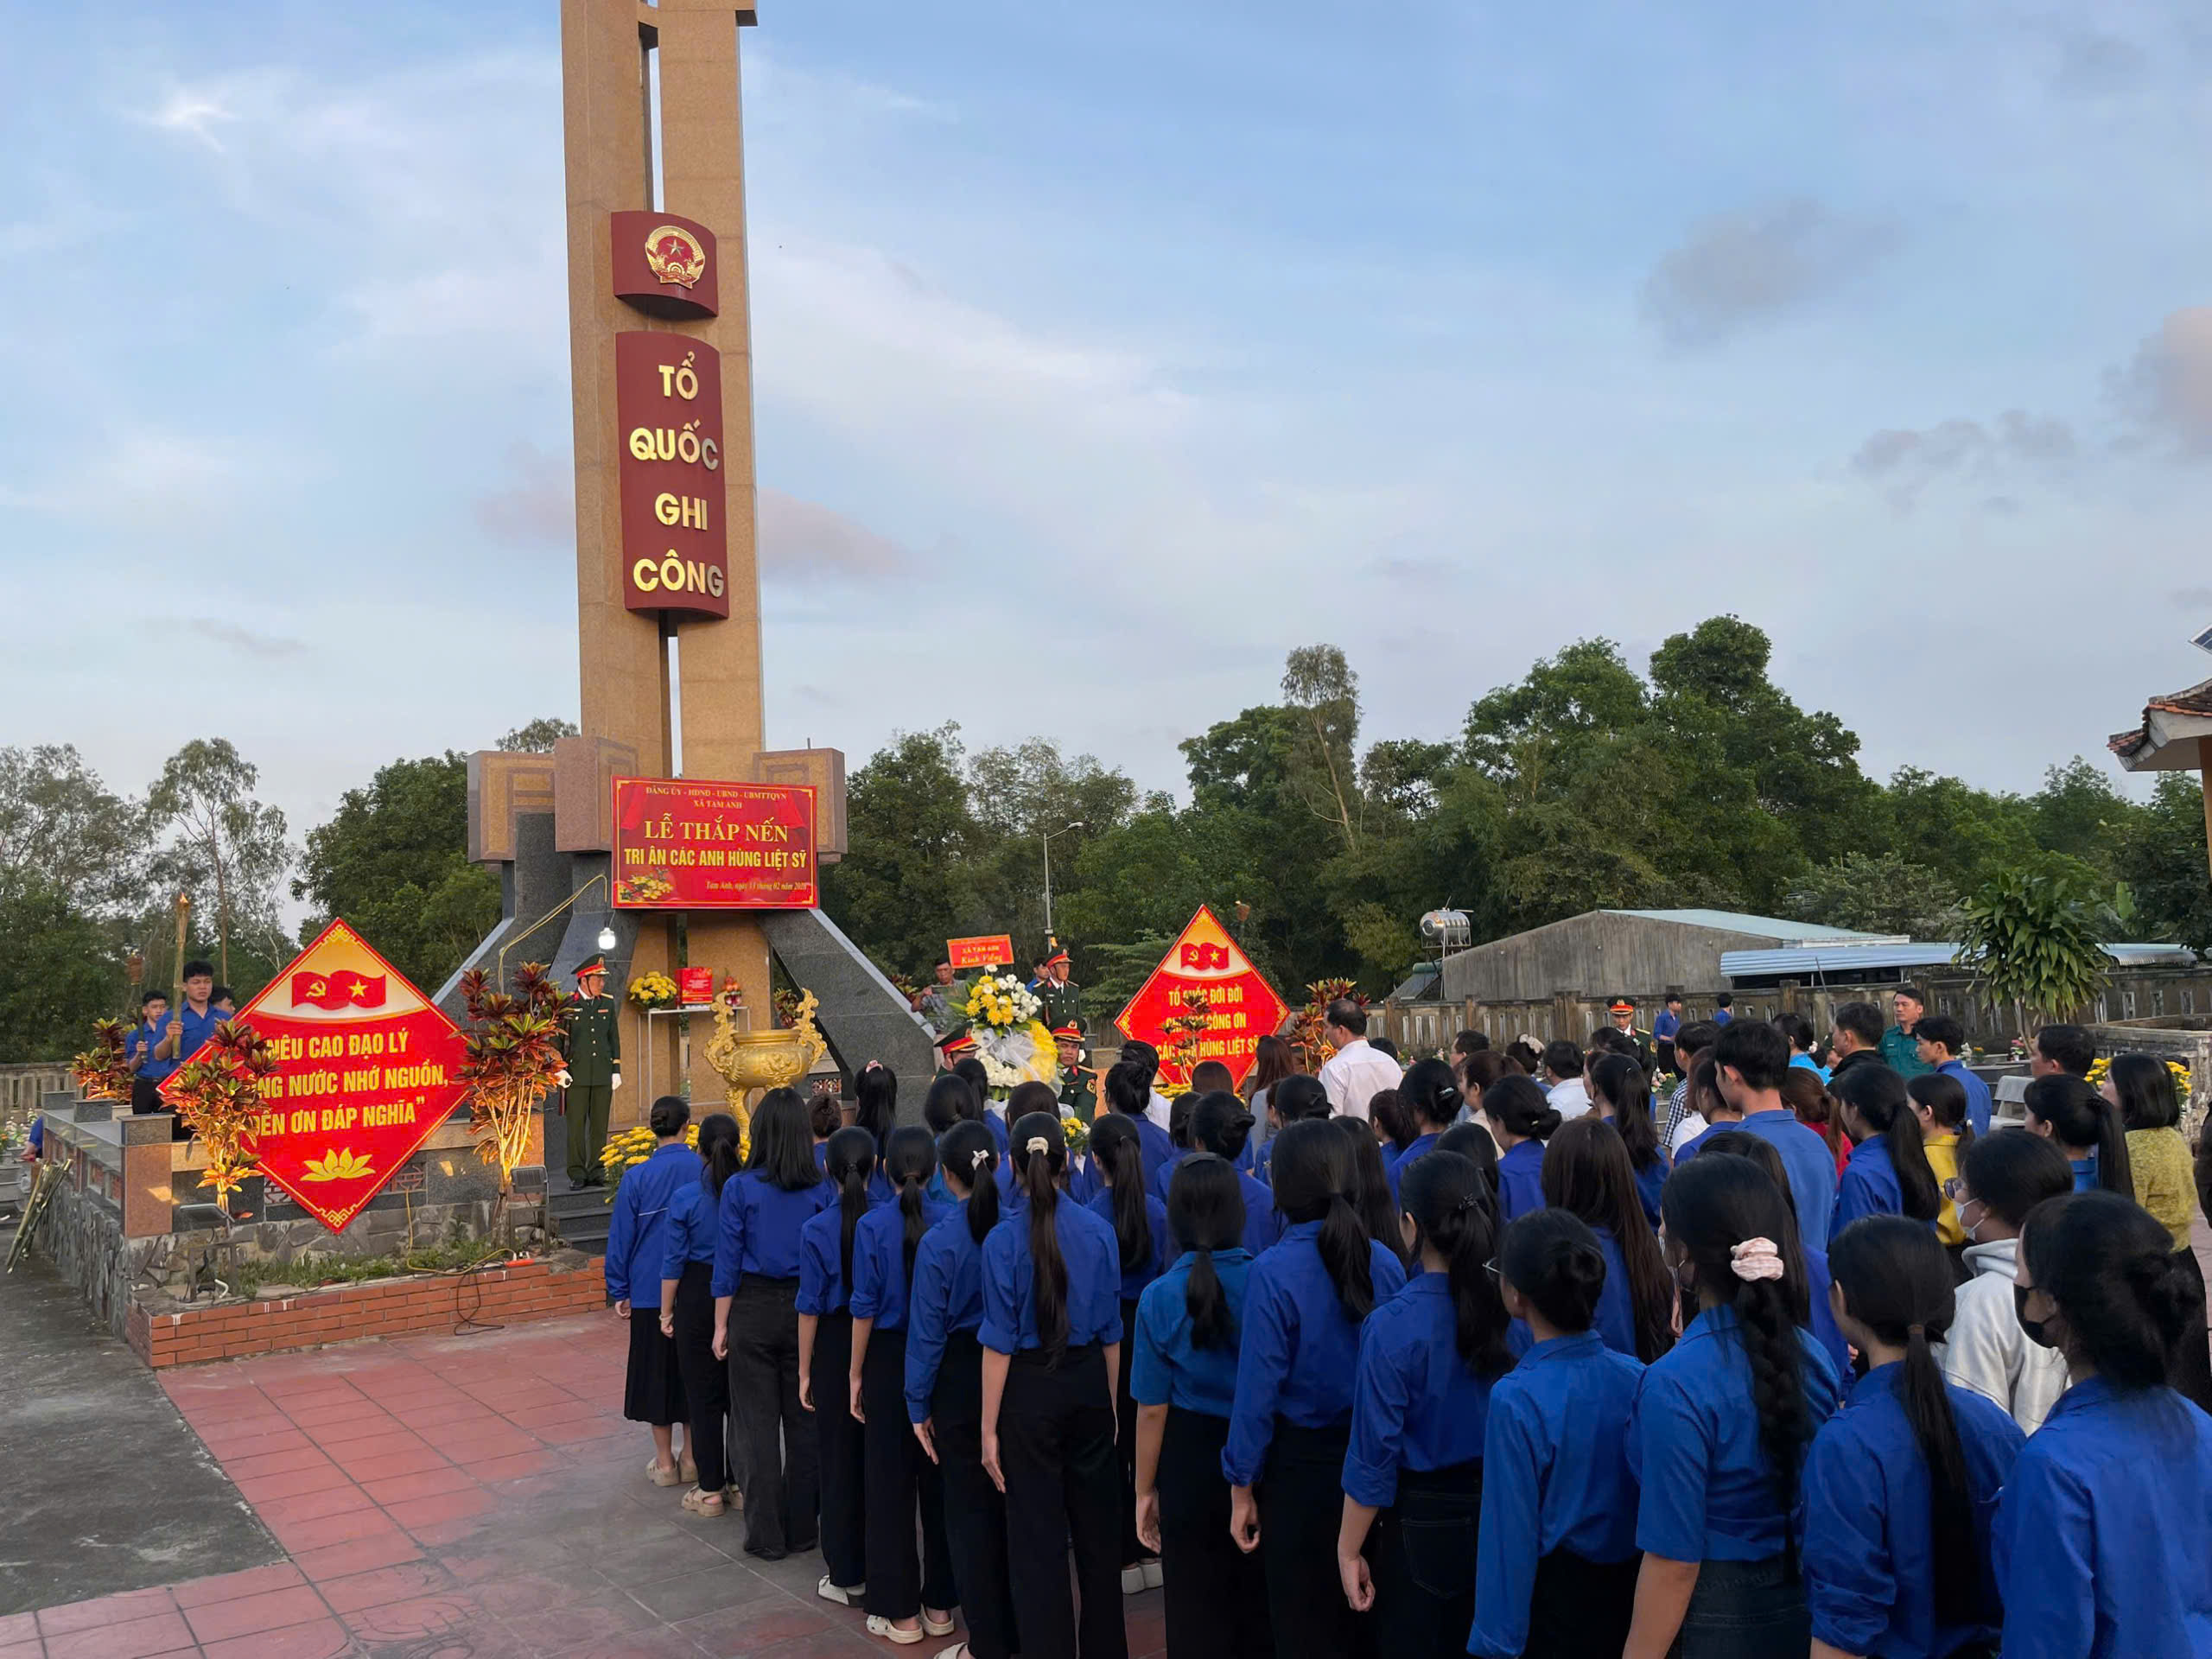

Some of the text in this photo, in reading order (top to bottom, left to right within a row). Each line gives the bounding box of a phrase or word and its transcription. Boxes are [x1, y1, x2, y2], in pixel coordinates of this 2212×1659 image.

[658, 351, 699, 401] TỔ
[628, 418, 719, 471] QUỐC
[654, 492, 708, 531] GHI
[632, 549, 724, 598] CÔNG
[705, 800, 724, 809] TAM
[725, 801, 743, 810] ANH
[644, 812, 789, 843] LỄ THẮP NẾN
[624, 845, 808, 871] TRI ÂN CÁC ANH HÙNG LIỆT SỸ
[1206, 1011, 1231, 1031] CÔNG
[1233, 1011, 1247, 1029] ƠN
[266, 1027, 409, 1061] NÊU CAO ĐẠO LÝ
[1199, 1038, 1225, 1058] HÙNG
[1227, 1036, 1245, 1058] LIỆT
[289, 1069, 338, 1097] NƯỚC
[343, 1065, 381, 1093] NHỚ
[291, 1109, 316, 1135] ƠN
[321, 1103, 358, 1131] ĐÁP
